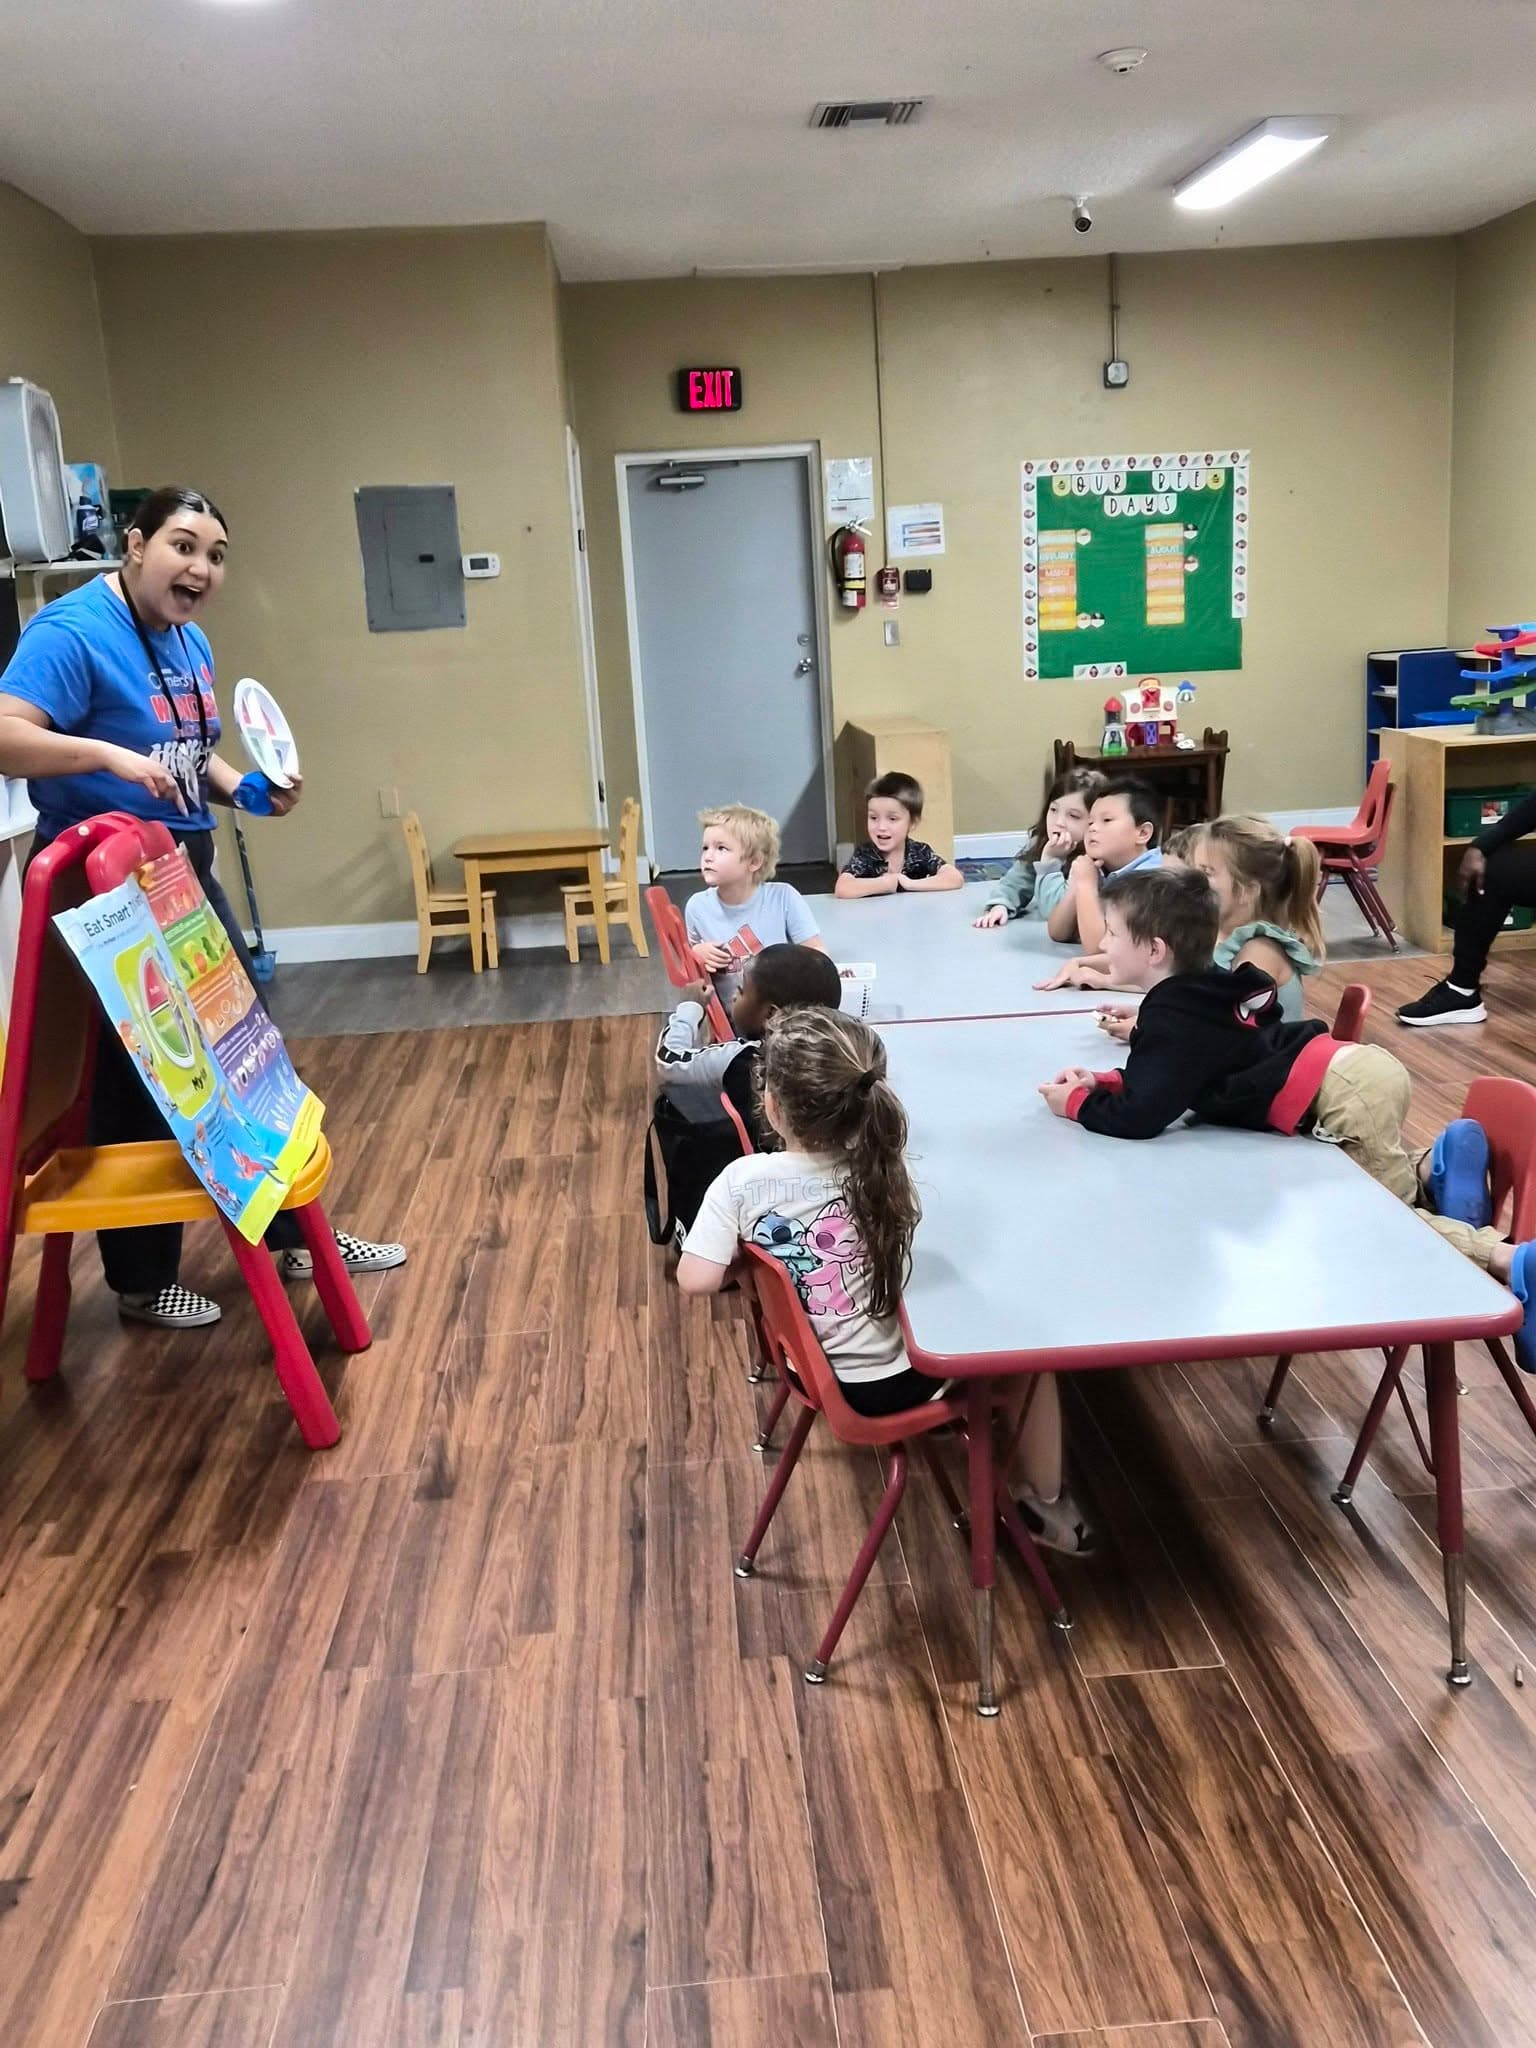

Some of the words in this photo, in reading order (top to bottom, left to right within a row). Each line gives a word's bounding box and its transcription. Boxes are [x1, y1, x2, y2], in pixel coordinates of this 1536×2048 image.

[689, 370, 734, 409] EXIT
[1076, 474, 1121, 490] OUR
[1109, 496, 1171, 513] DAYS
[83, 918, 105, 937] Eat
[102, 905, 131, 928] Smart
